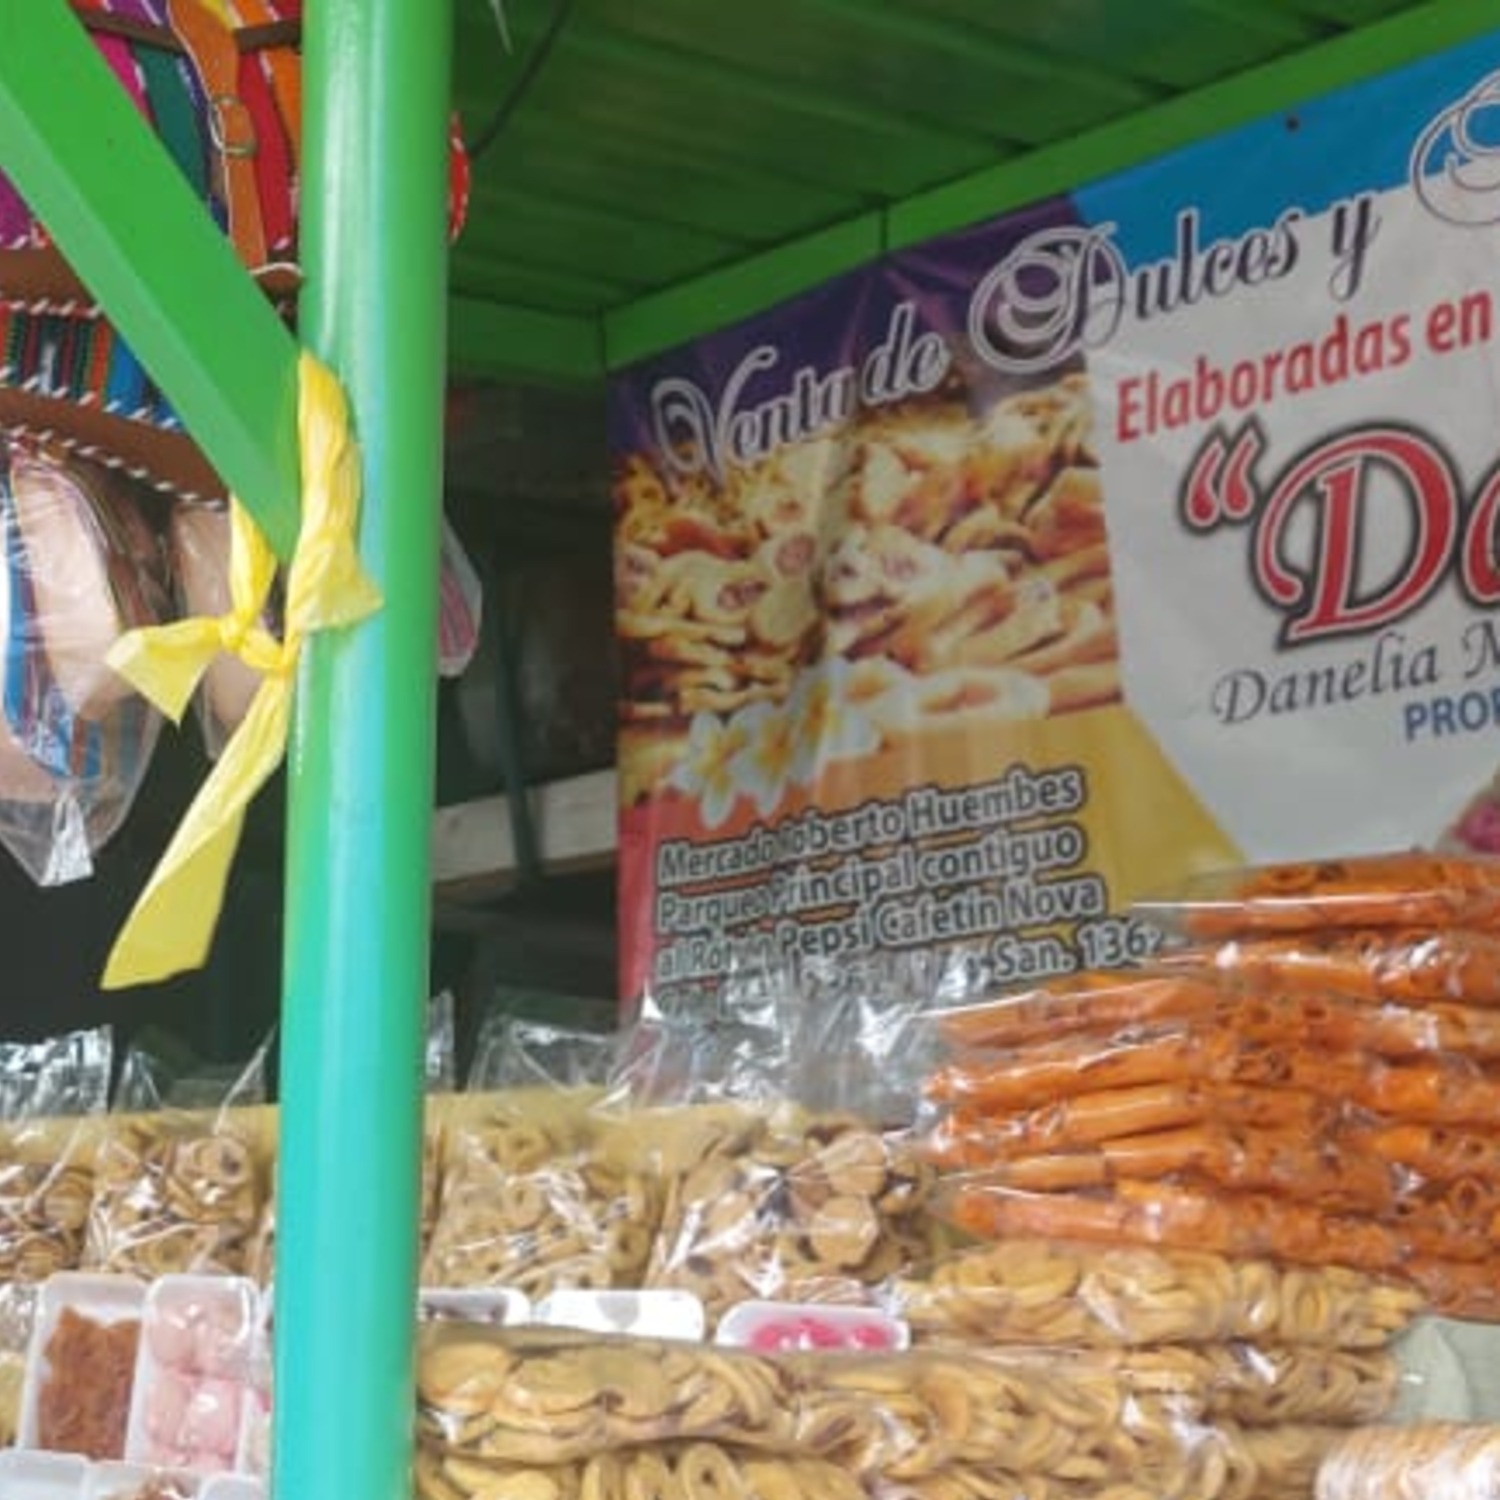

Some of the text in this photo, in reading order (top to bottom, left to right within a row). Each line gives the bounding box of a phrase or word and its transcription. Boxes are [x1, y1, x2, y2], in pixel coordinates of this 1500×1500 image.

[651, 189, 1383, 492] Venta de Dulces y
[1115, 289, 1493, 444] Elaboradas en
[1211, 629, 1440, 725] Danelia
[659, 830, 775, 887] Mercado
[908, 769, 1083, 836] Huembes
[771, 850, 913, 912] Principal
[919, 828, 1081, 879] contiguo
[780, 912, 871, 957] Pepsi
[1004, 879, 1102, 922] Nova
